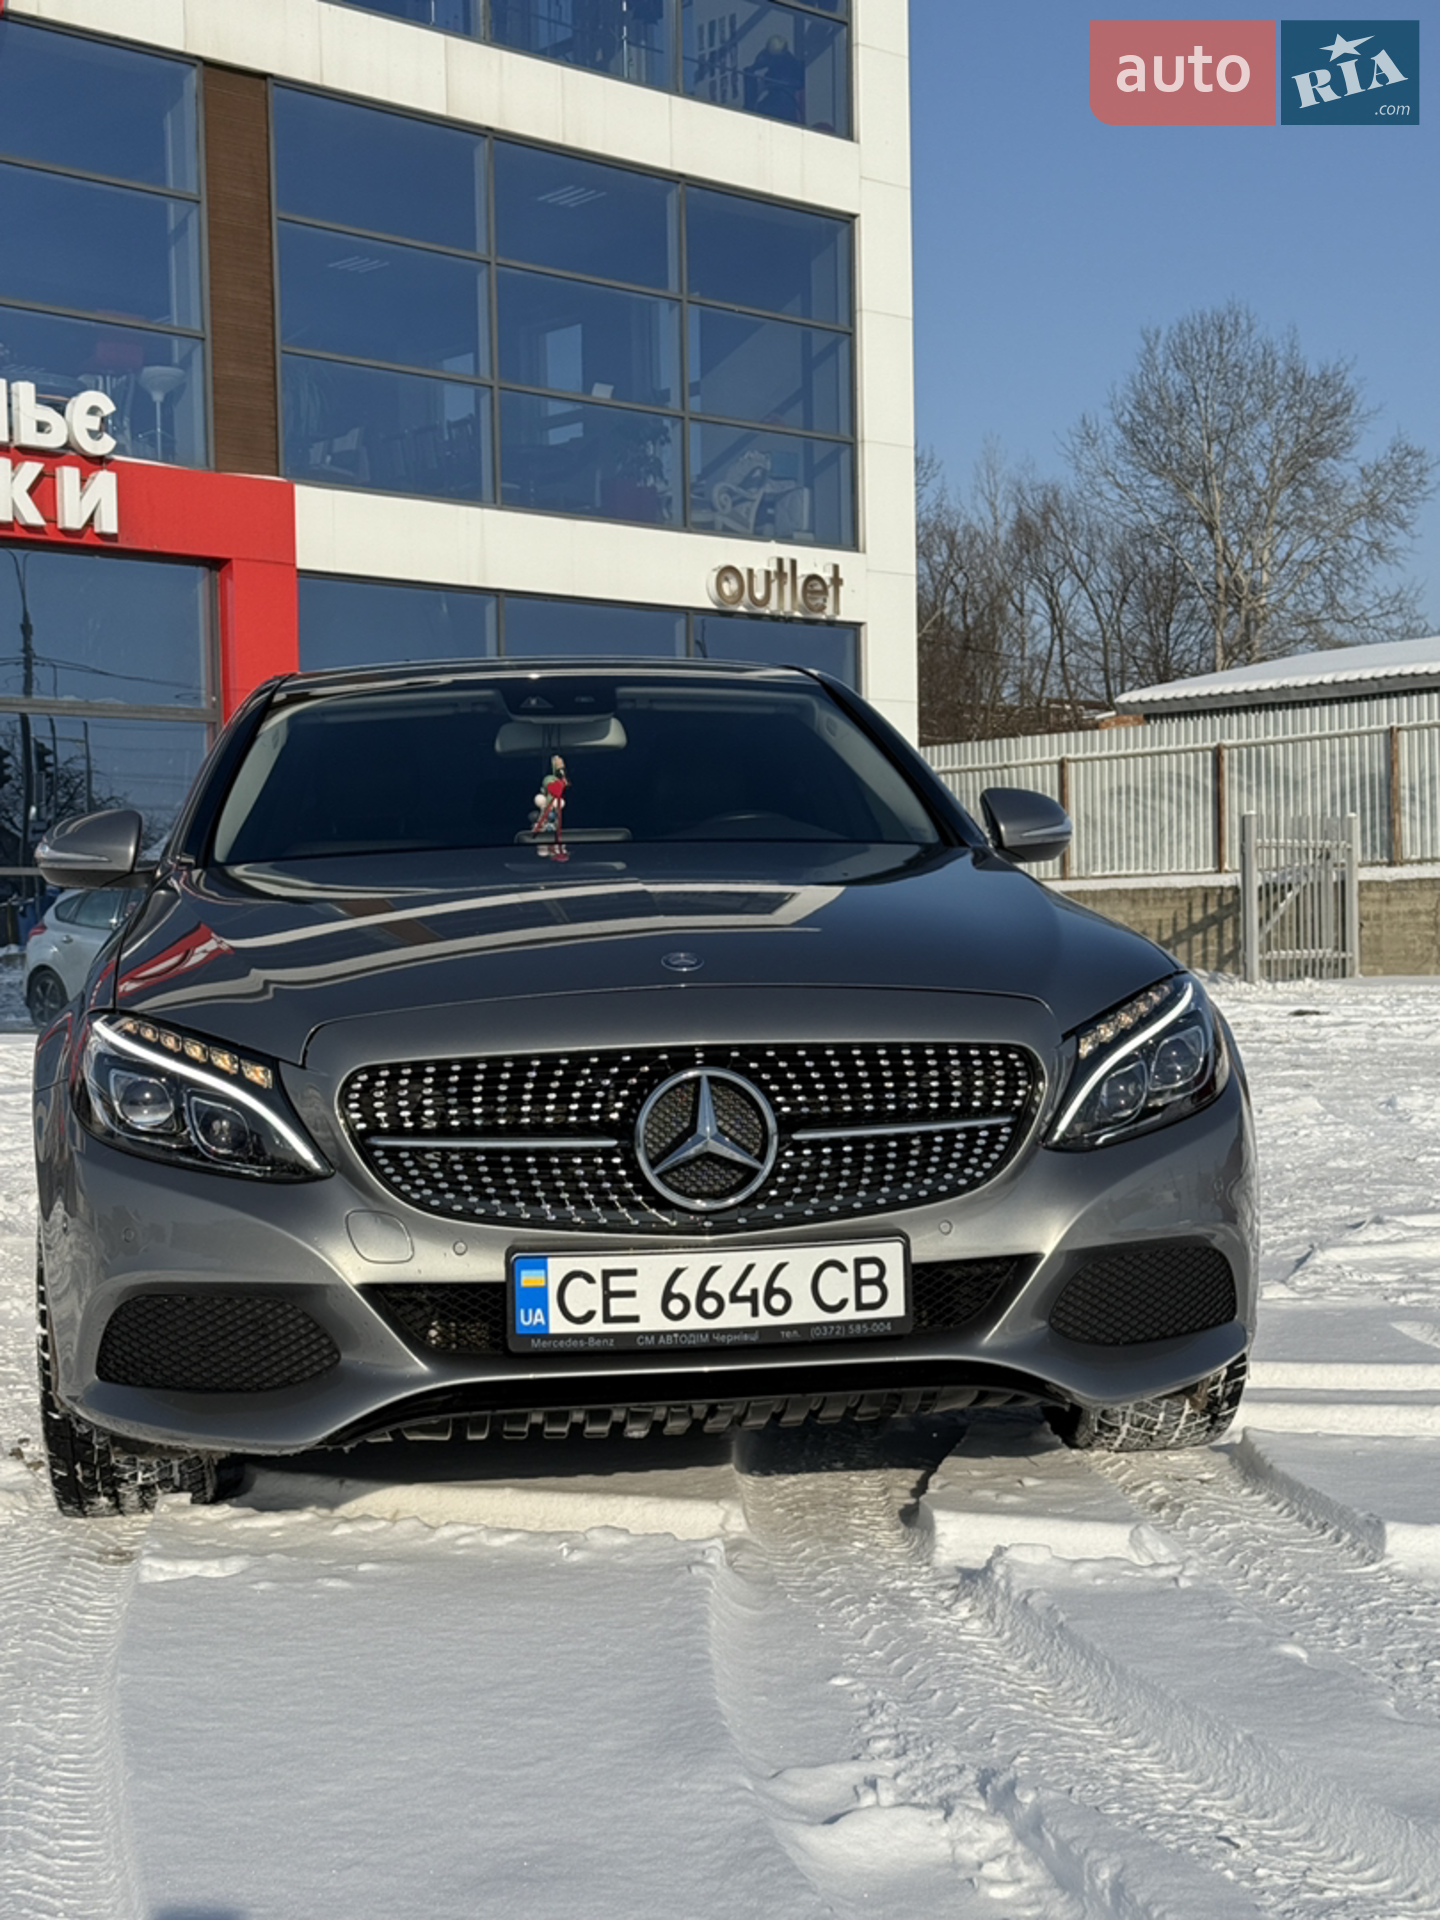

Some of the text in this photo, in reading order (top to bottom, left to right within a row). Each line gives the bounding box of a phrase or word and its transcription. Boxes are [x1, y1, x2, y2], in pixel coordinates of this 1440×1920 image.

[0, 378, 117, 457] ЬЄ
[707, 556, 844, 618] outlet
[556, 1256, 890, 1325] CE 6646 CB
[520, 1308, 546, 1326] UA
[810, 1325, 846, 1338] (0372)
[530, 1336, 615, 1349] Mercedes-Benz
